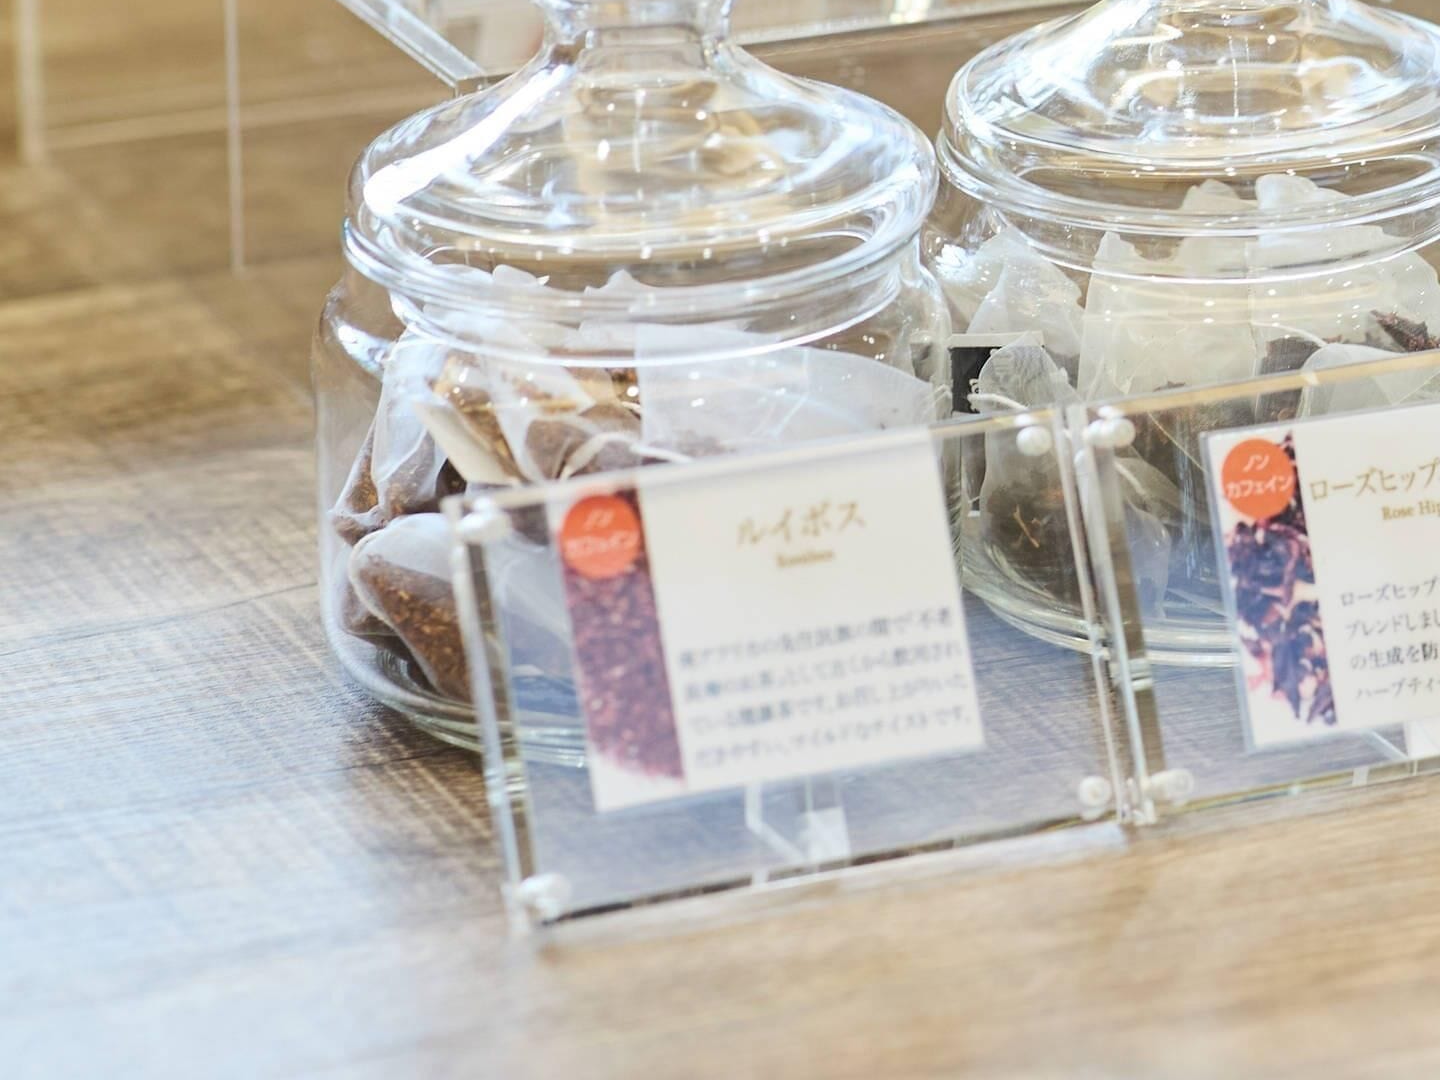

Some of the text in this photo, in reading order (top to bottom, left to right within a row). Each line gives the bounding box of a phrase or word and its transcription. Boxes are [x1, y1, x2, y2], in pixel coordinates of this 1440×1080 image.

[1243, 453, 1270, 472] ノン
[1226, 474, 1294, 500] カフェイン
[1381, 505, 1414, 520] Rose
[735, 499, 868, 552] ルイボス
